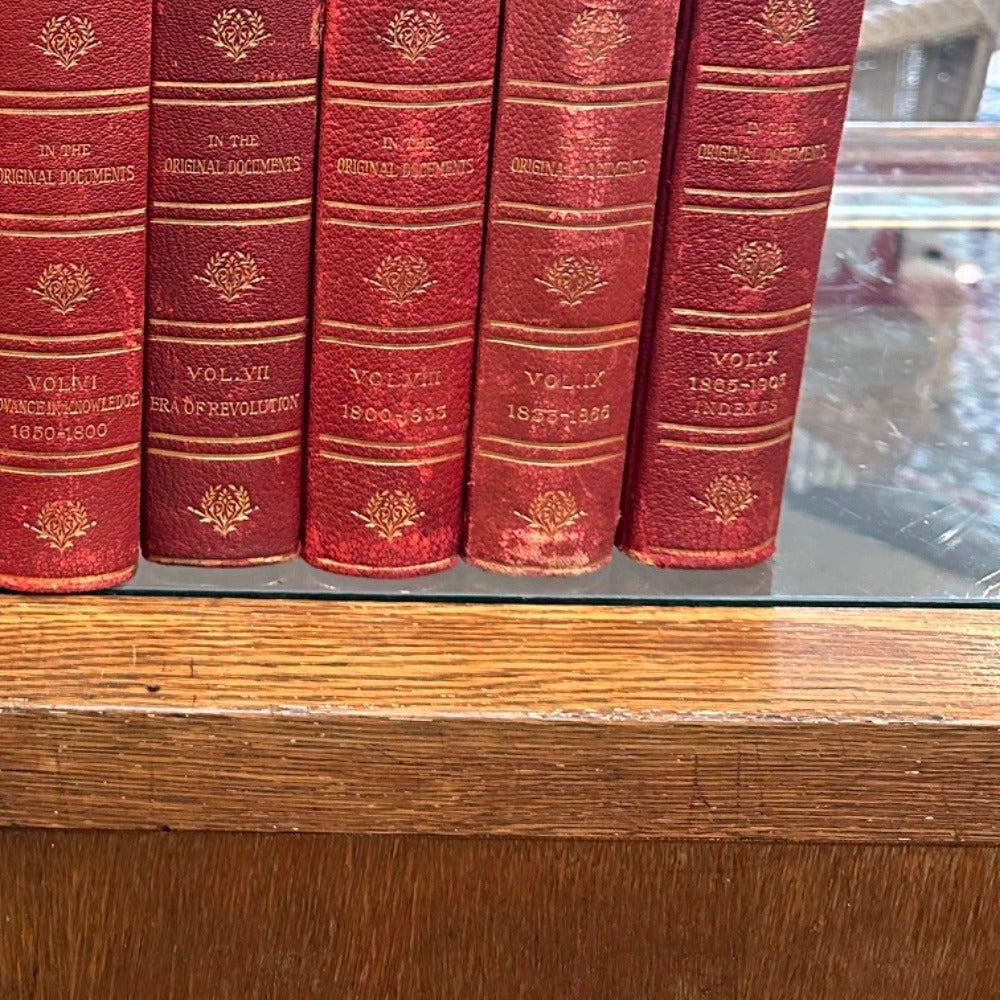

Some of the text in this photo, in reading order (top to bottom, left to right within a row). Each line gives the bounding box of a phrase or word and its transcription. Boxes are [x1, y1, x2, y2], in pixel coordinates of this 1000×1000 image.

[207, 134, 260, 147] IN THE
[382, 136, 398, 149] IN
[39, 144, 91, 157] IN THE
[699, 143, 759, 162] ORIGINAL
[164, 155, 301, 175] ORIGINAL DOCUMENTS
[337, 157, 398, 178] ORIGINAL
[60, 165, 135, 185] DOCUMENTS
[62, 392, 140, 415] KNOWLEDGE
[150, 394, 300, 416] ERA OF REVOLUTION
[693, 400, 778, 416] INDEXES
[10, 423, 108, 441] 1650-1800
